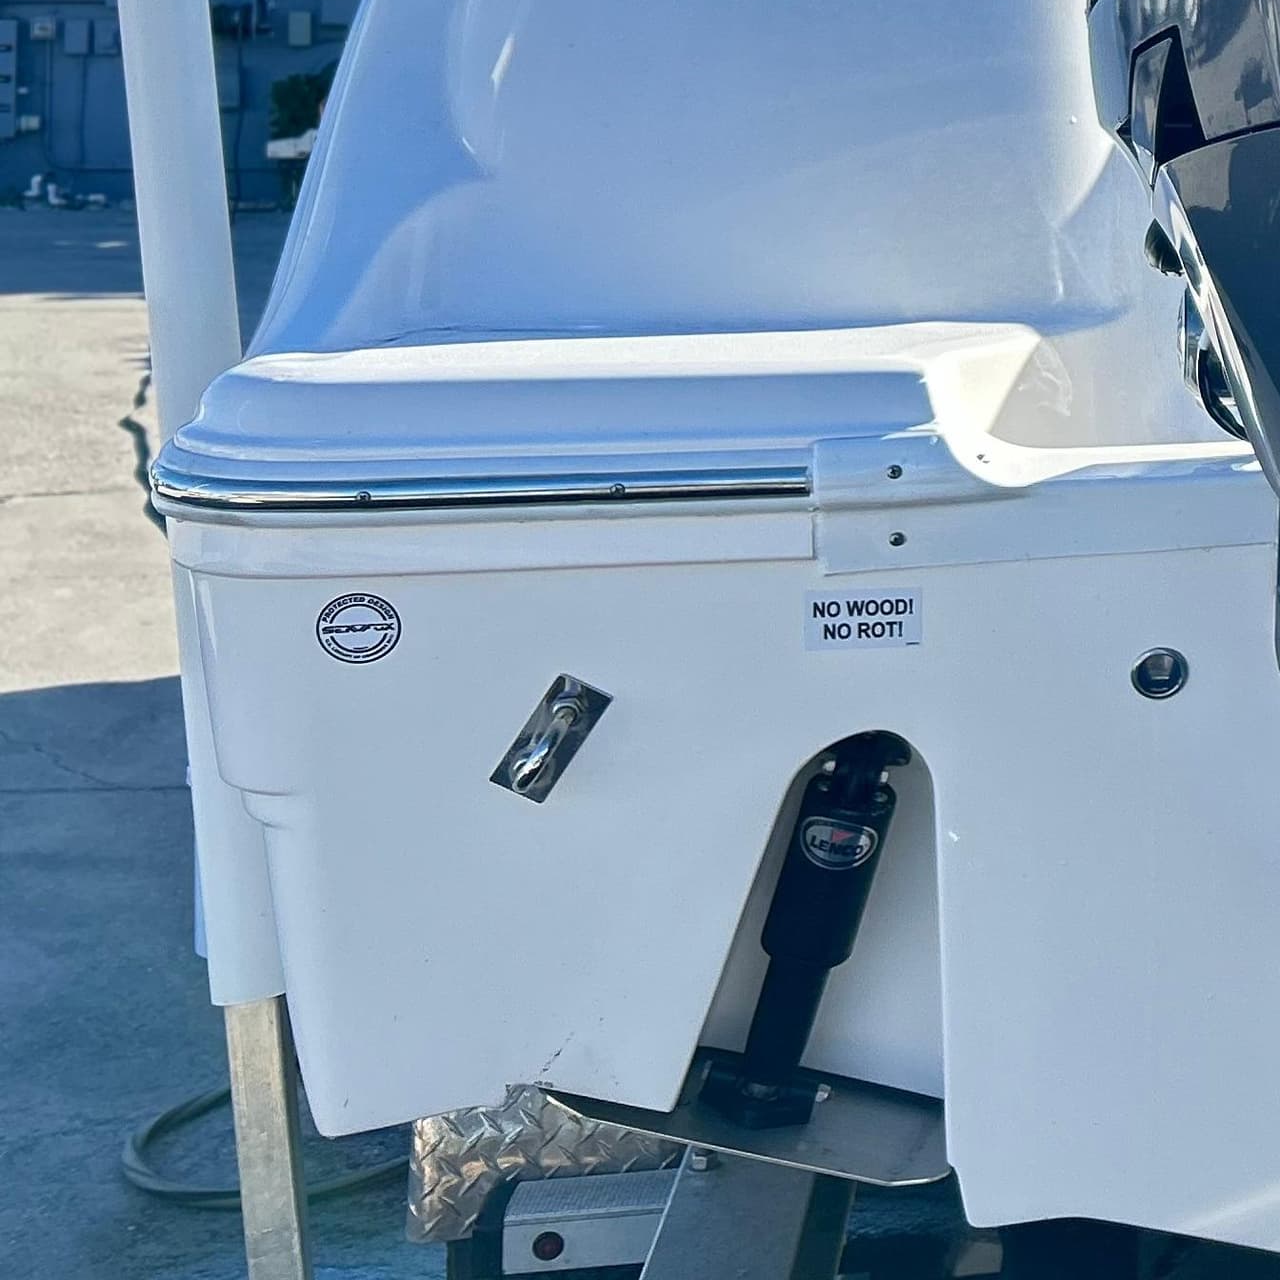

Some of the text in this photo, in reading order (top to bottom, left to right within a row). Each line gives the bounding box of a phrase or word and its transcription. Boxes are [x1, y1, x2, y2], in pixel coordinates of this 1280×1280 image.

[321, 596, 395, 623] PROTECTED DESIGN
[812, 599, 914, 618] NO WOOD!
[823, 621, 904, 640] NO ROT!
